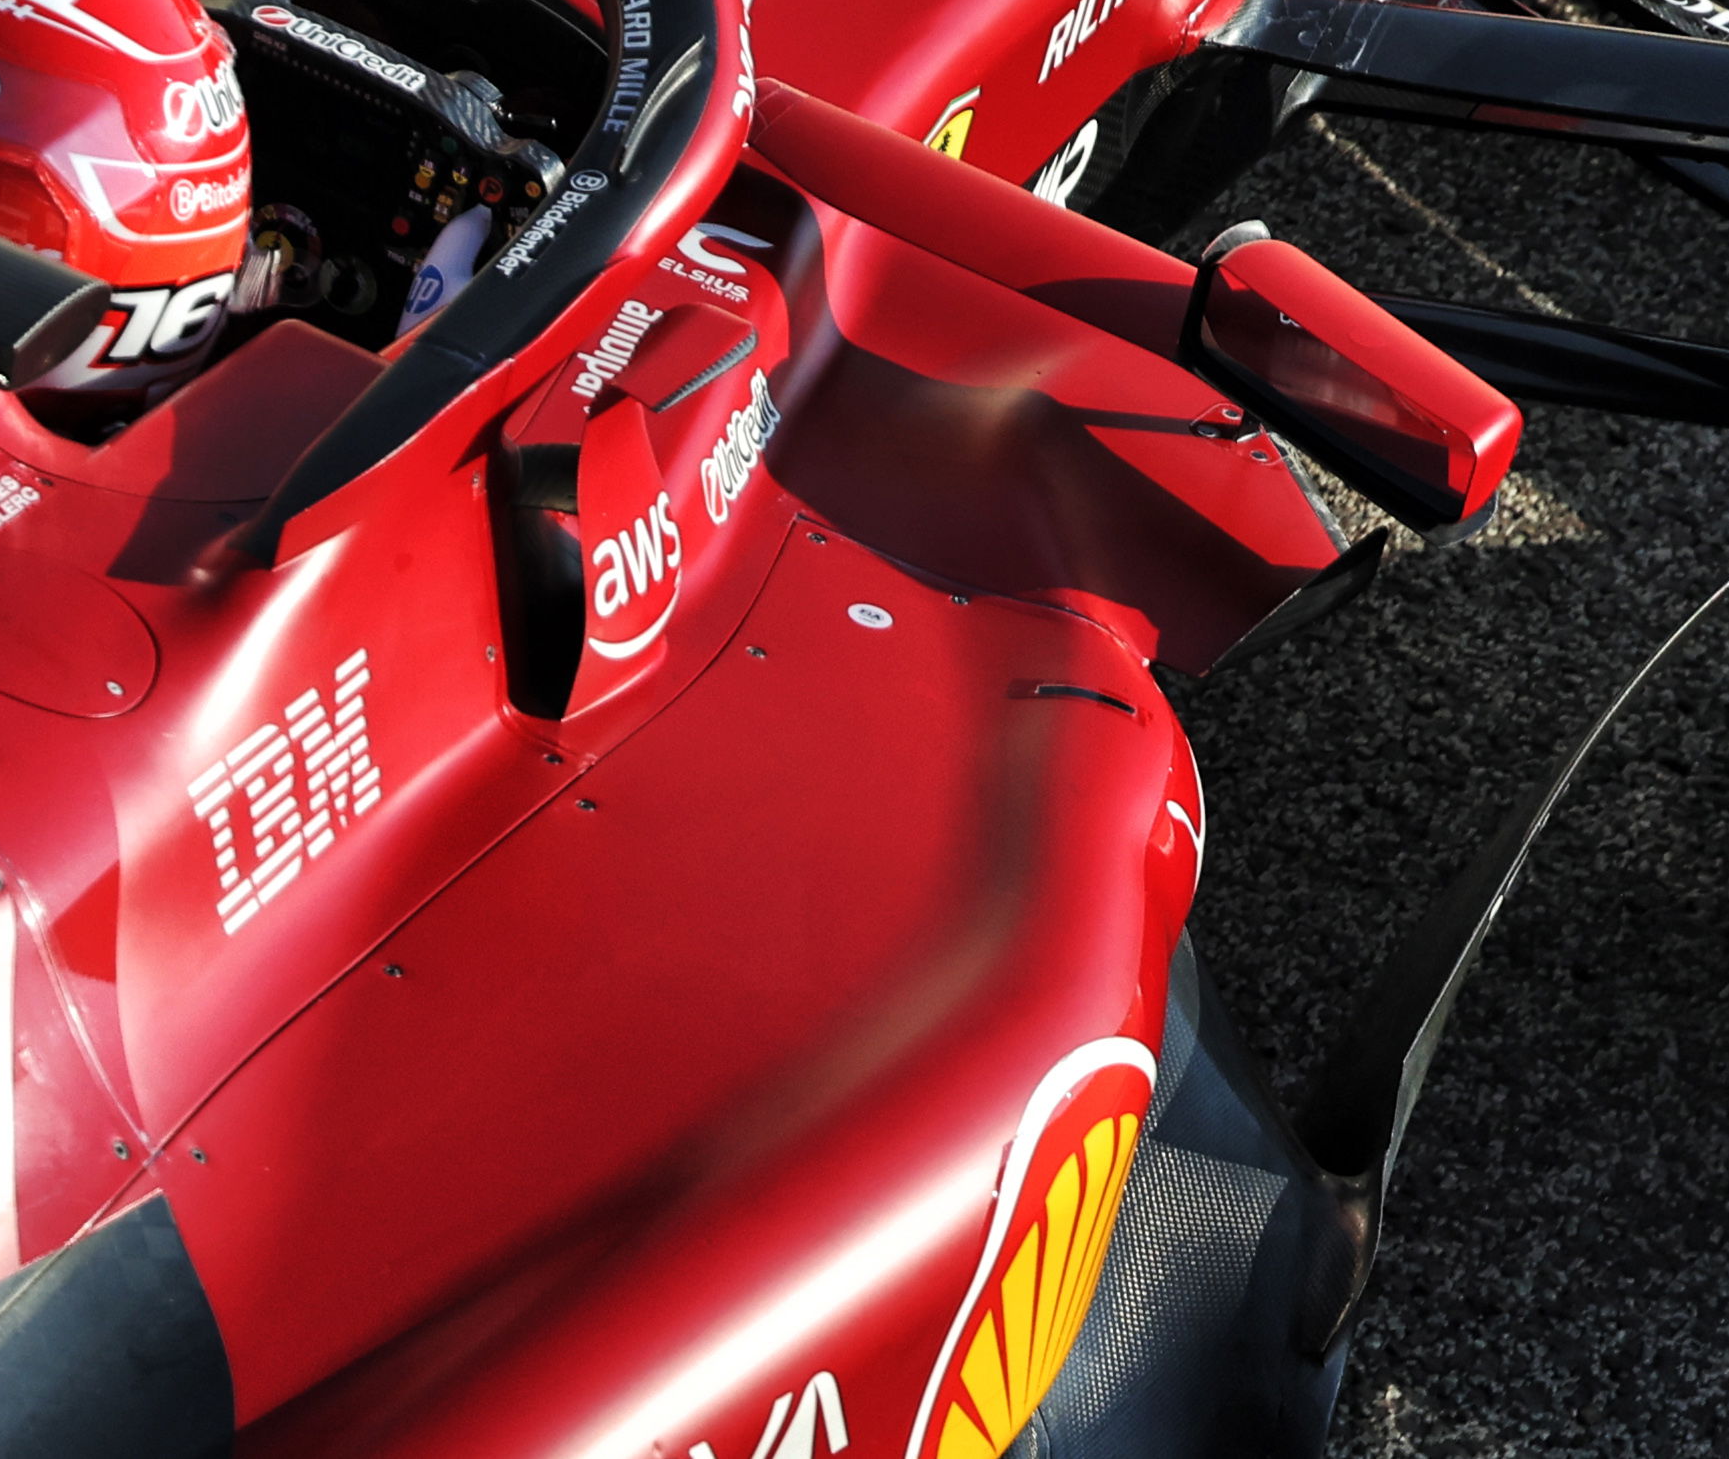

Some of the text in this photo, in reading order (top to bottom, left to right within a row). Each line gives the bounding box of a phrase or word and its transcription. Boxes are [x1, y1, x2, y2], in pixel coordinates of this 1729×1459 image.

[286, 18, 427, 93] UniCredit
[601, 58, 648, 133] MILLE
[494, 188, 591, 278] Bitdefender
[106, 275, 233, 361] 16
[592, 490, 681, 618] aws
[187, 647, 381, 936] IBM
